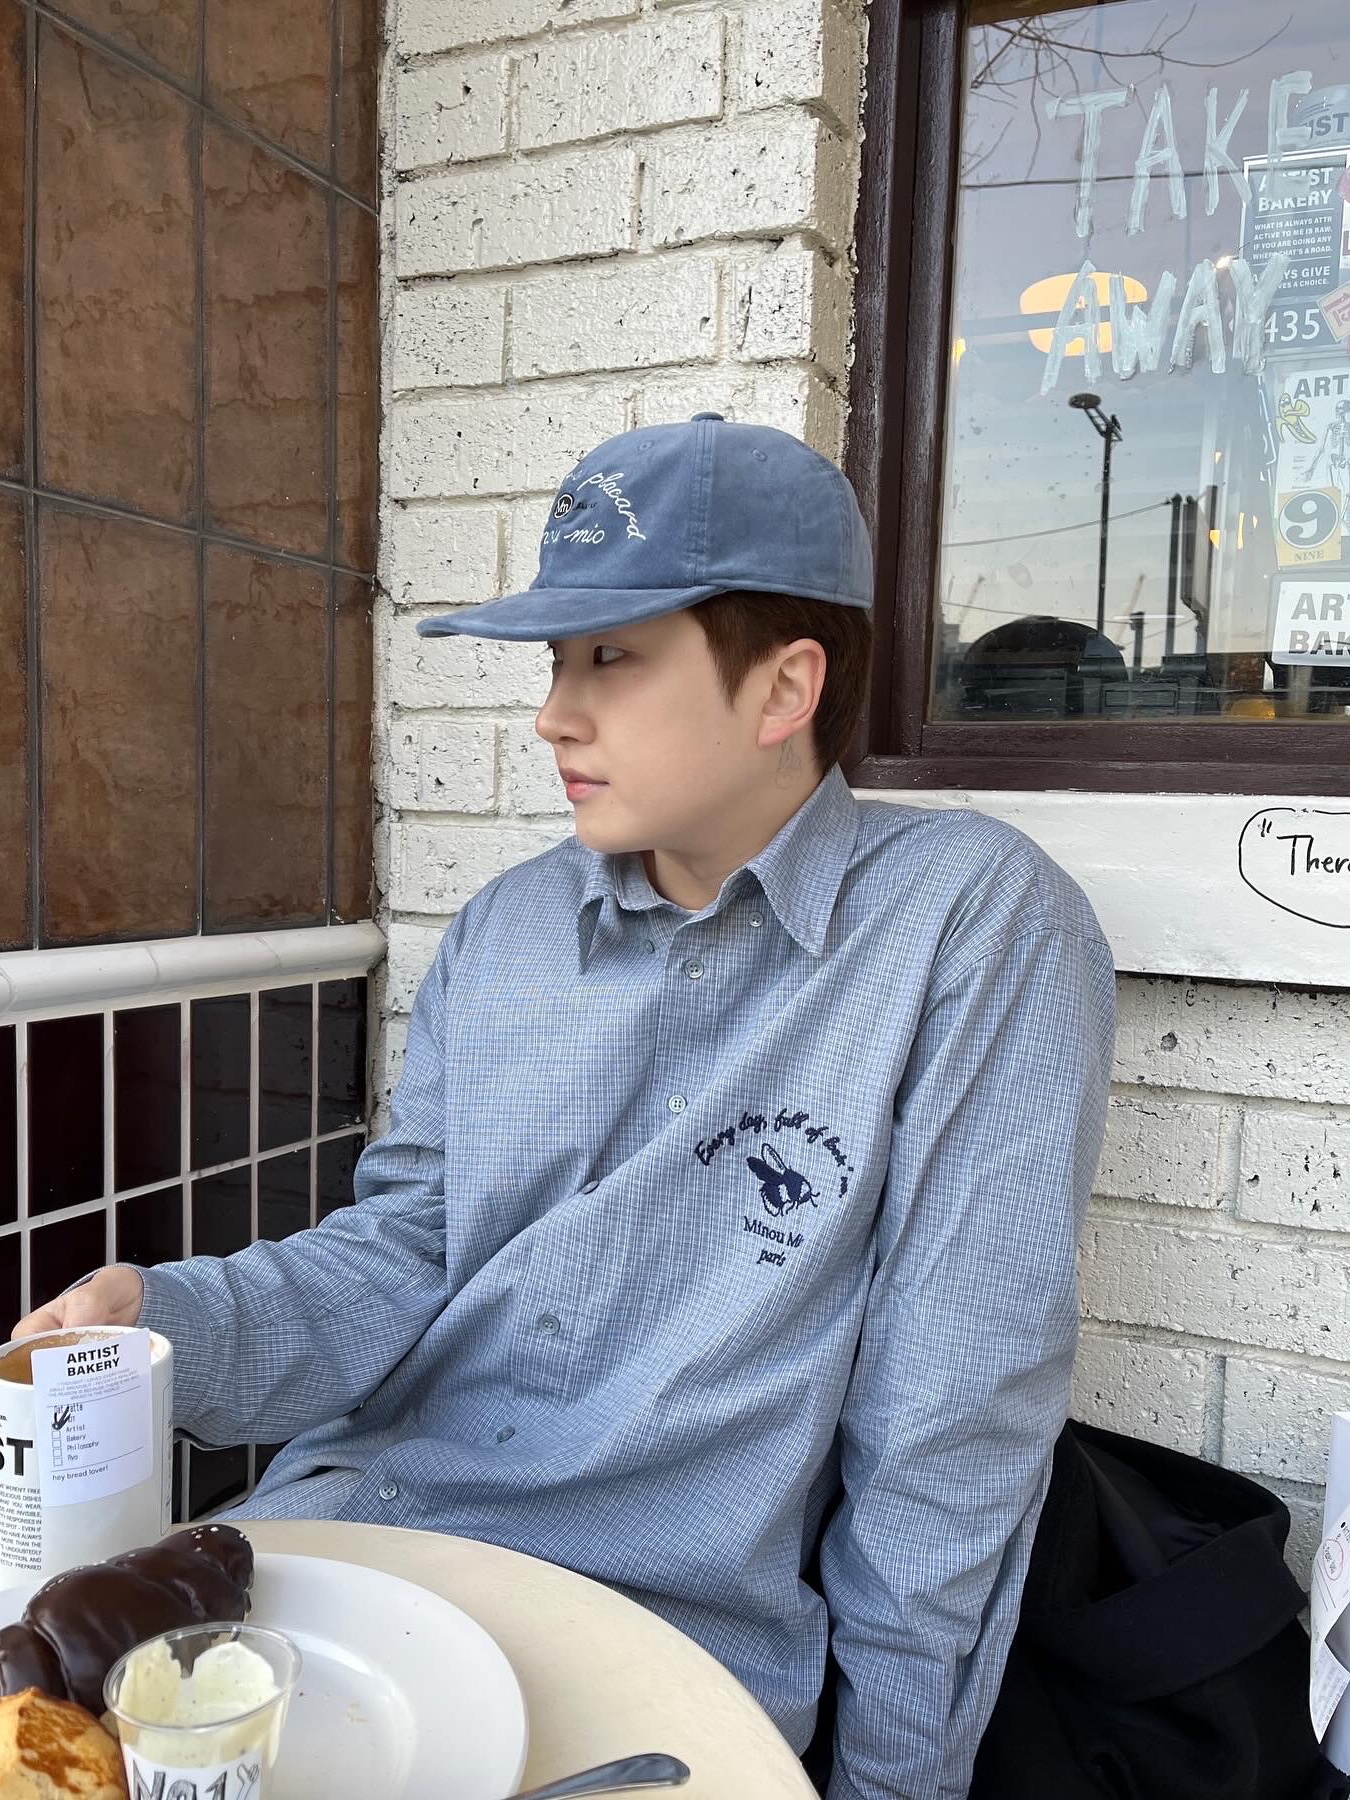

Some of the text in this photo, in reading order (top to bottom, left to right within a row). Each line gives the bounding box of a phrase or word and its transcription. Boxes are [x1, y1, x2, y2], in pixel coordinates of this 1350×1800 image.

[1045, 70, 1312, 238] TAKE
[1258, 188, 1333, 212] BAKERY
[1253, 231, 1280, 241] ACTIVE
[1305, 227, 1313, 235] IS
[1254, 222, 1275, 231] WHAT
[1276, 221, 1283, 229] IS
[1284, 217, 1313, 227] ALWAYS
[1253, 243, 1260, 251] IF
[1277, 240, 1291, 248] ARE
[1292, 237, 1316, 246] GOING
[1301, 265, 1331, 278] GIVE
[1040, 255, 1291, 396] AWAY
[1293, 374, 1350, 399] ART
[1284, 493, 1336, 546] 9
[564, 523, 605, 544] mio
[1293, 550, 1325, 562] NINE
[1290, 592, 1350, 621] AR
[805, 1126, 829, 1144] of
[743, 1215, 786, 1244] Minou
[756, 1249, 787, 1267] paris
[67, 1344, 119, 1364] ARTIST
[67, 1357, 120, 1377] BAKERY
[66, 1423, 85, 1433] Artist
[52, 1473, 65, 1481] hey
[66, 1469, 87, 1480] bread
